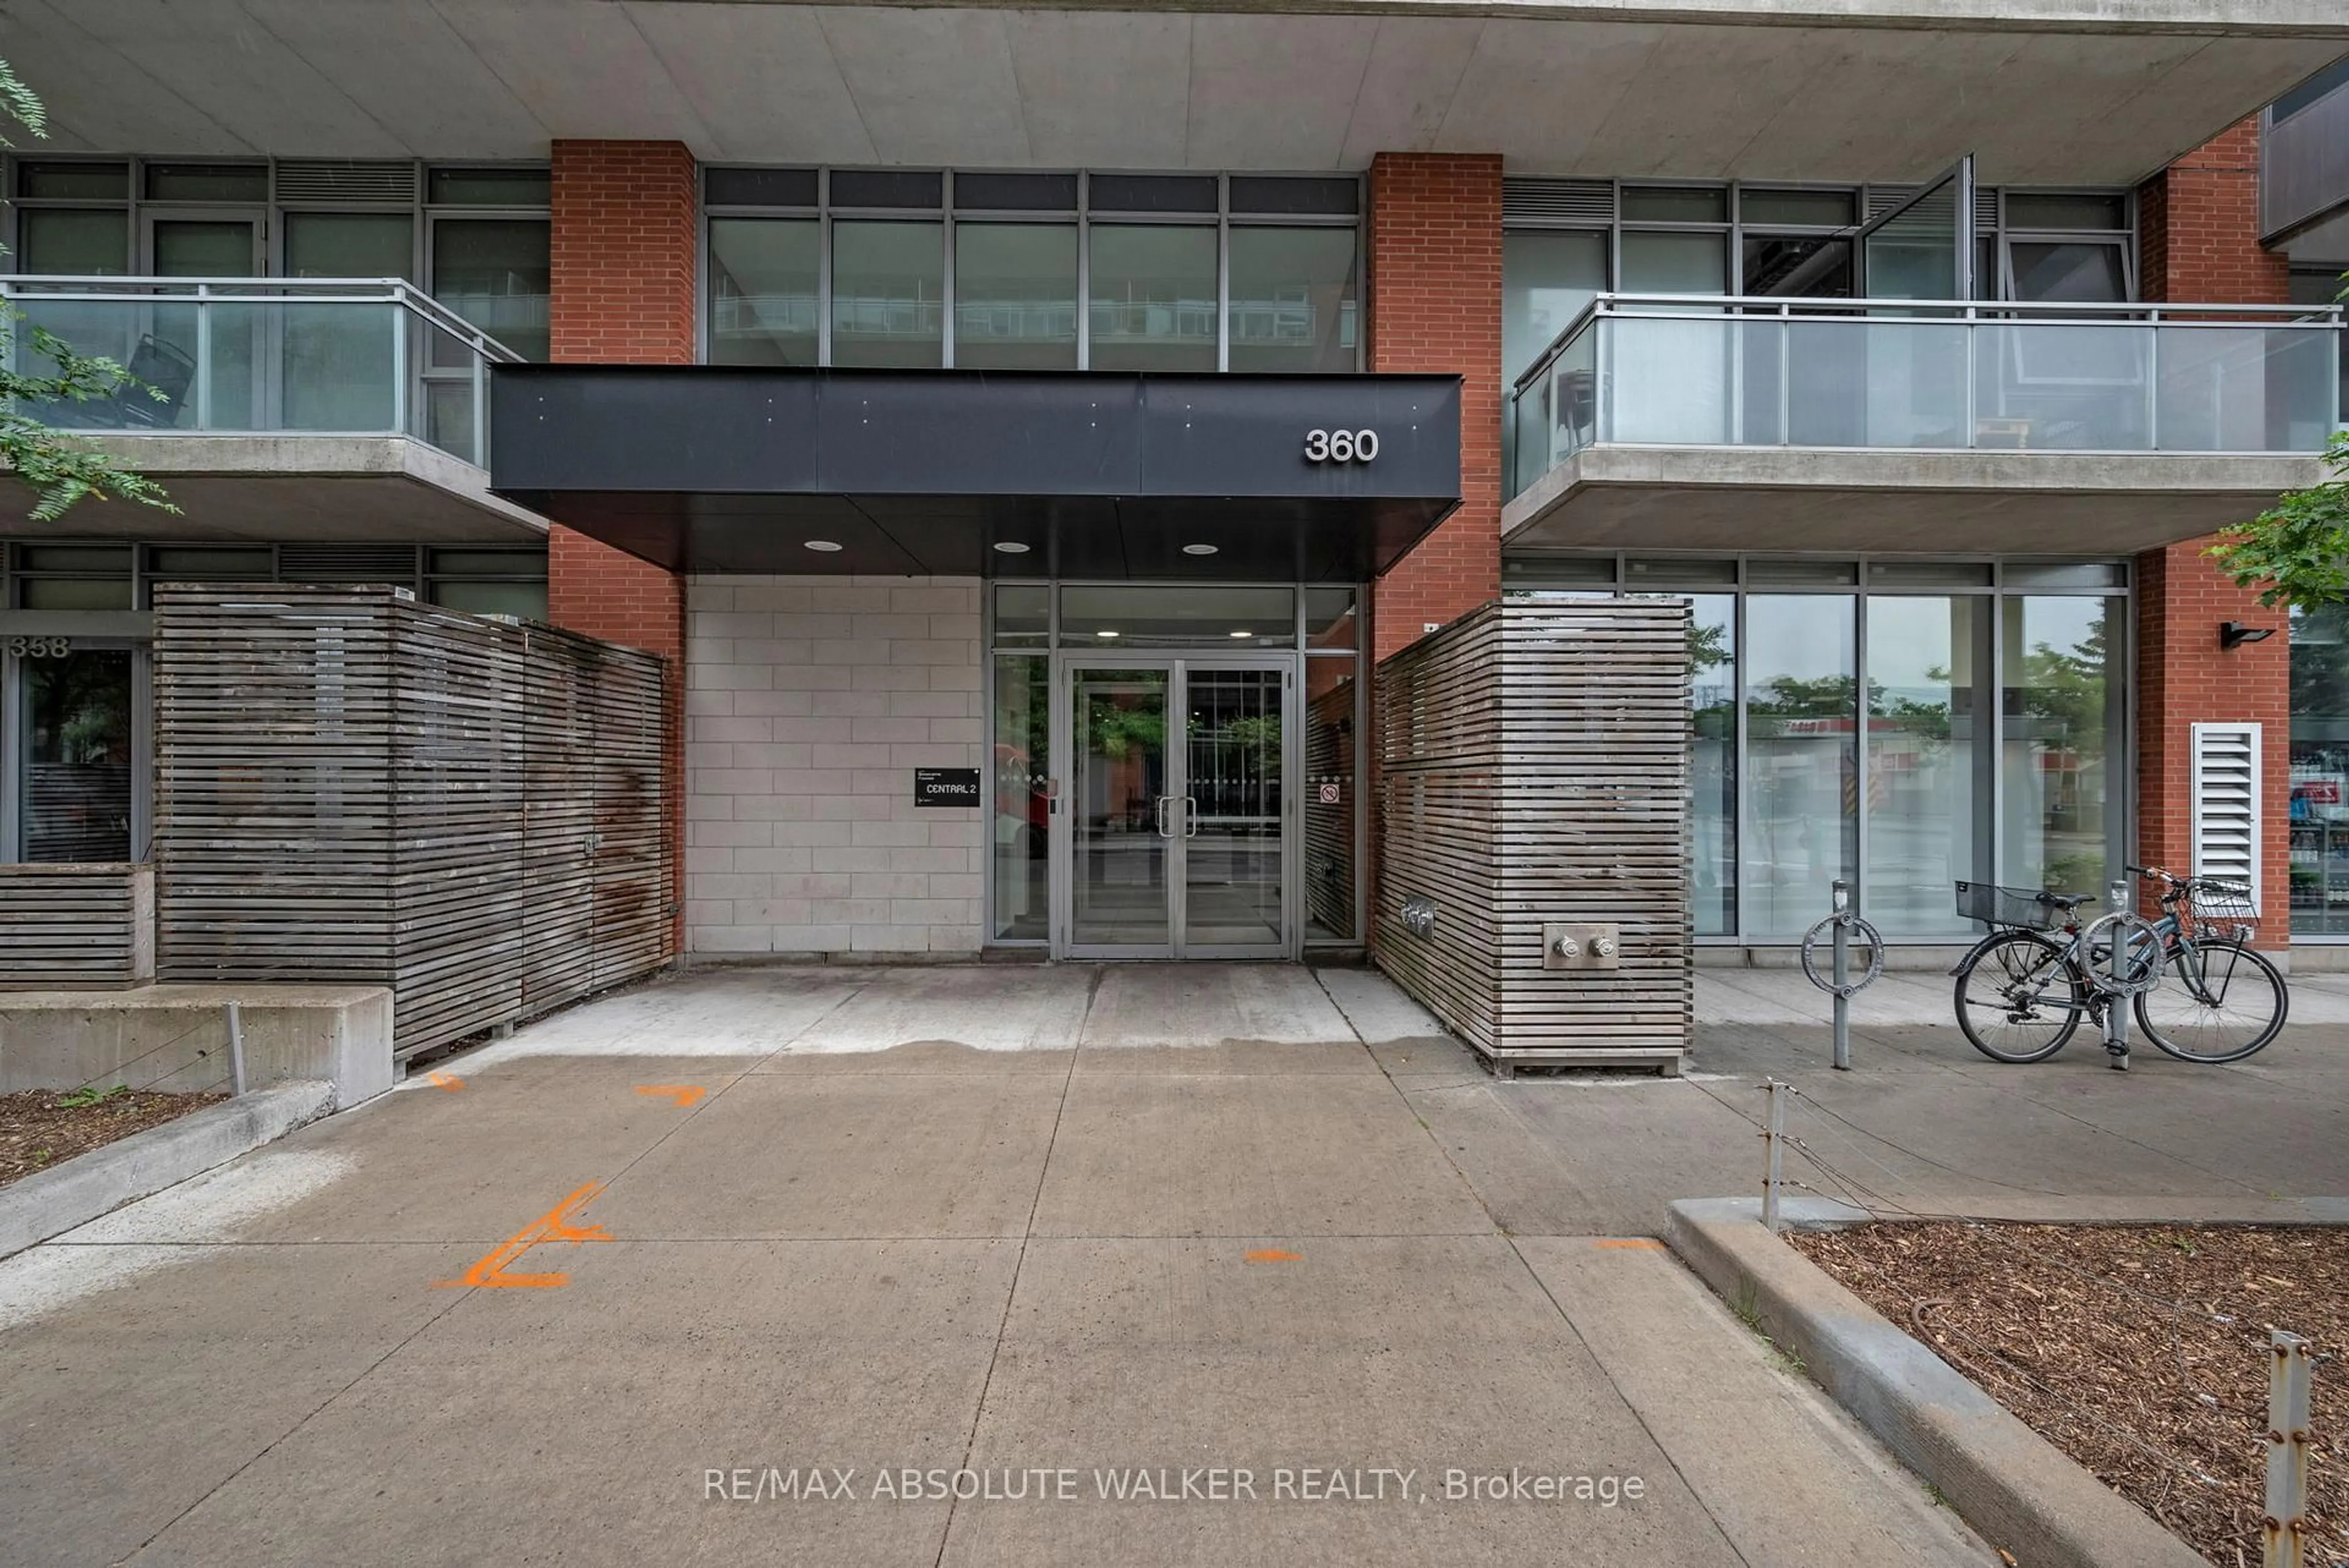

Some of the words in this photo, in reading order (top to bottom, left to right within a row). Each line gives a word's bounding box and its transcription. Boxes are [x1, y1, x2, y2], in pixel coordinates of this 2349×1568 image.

[1305, 429, 1379, 462] 360
[10, 636, 69, 658] 358
[926, 784, 969, 794] CENTRAL
[970, 784, 977, 794] 2
